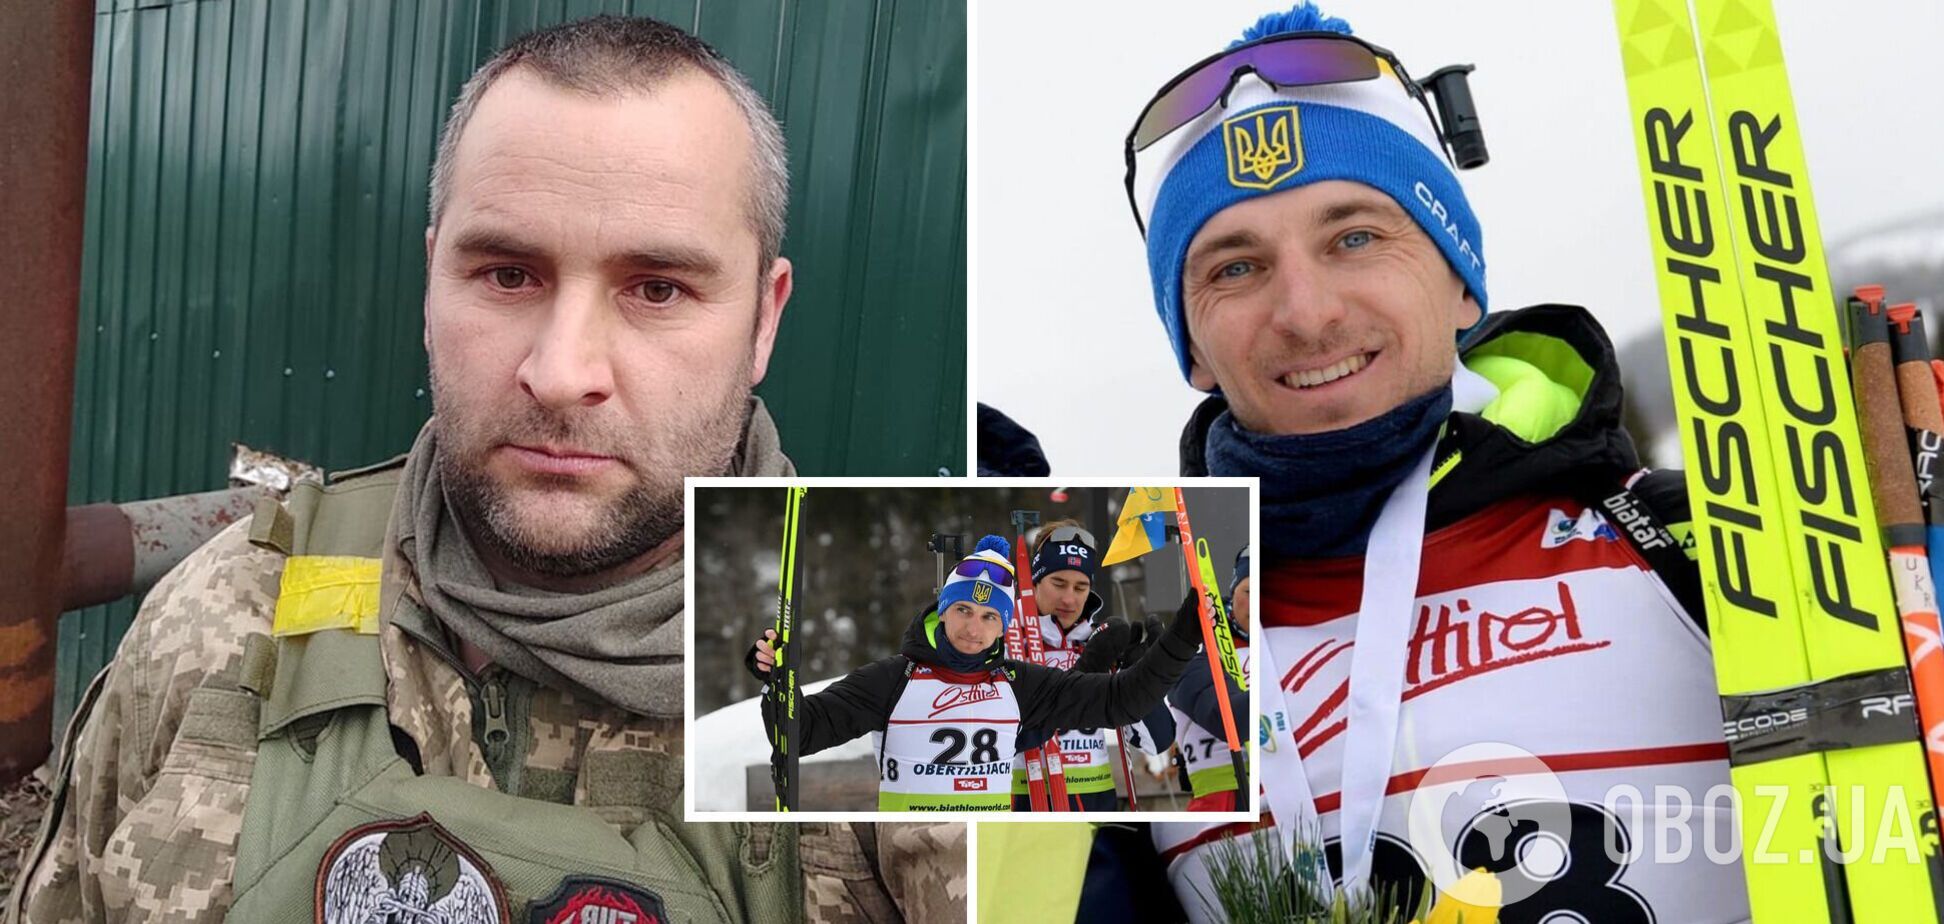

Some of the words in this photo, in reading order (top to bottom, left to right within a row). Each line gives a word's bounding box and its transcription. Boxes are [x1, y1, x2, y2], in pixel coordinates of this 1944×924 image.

[1413, 181, 1481, 270] CRAFT
[1644, 107, 1778, 619] FISCHER
[1728, 110, 1880, 632] FISCHER
[1603, 490, 1668, 550] biatar
[1008, 618, 1024, 662] SHUS
[1025, 616, 1043, 662] SHUS
[788, 669, 796, 720] FISCHER
[1275, 711, 1286, 732] IBU
[913, 762, 1010, 776] OBERTILLIACH
[928, 728, 999, 766] 28
[1184, 738, 1216, 764] 27
[958, 780, 984, 789] Tirol
